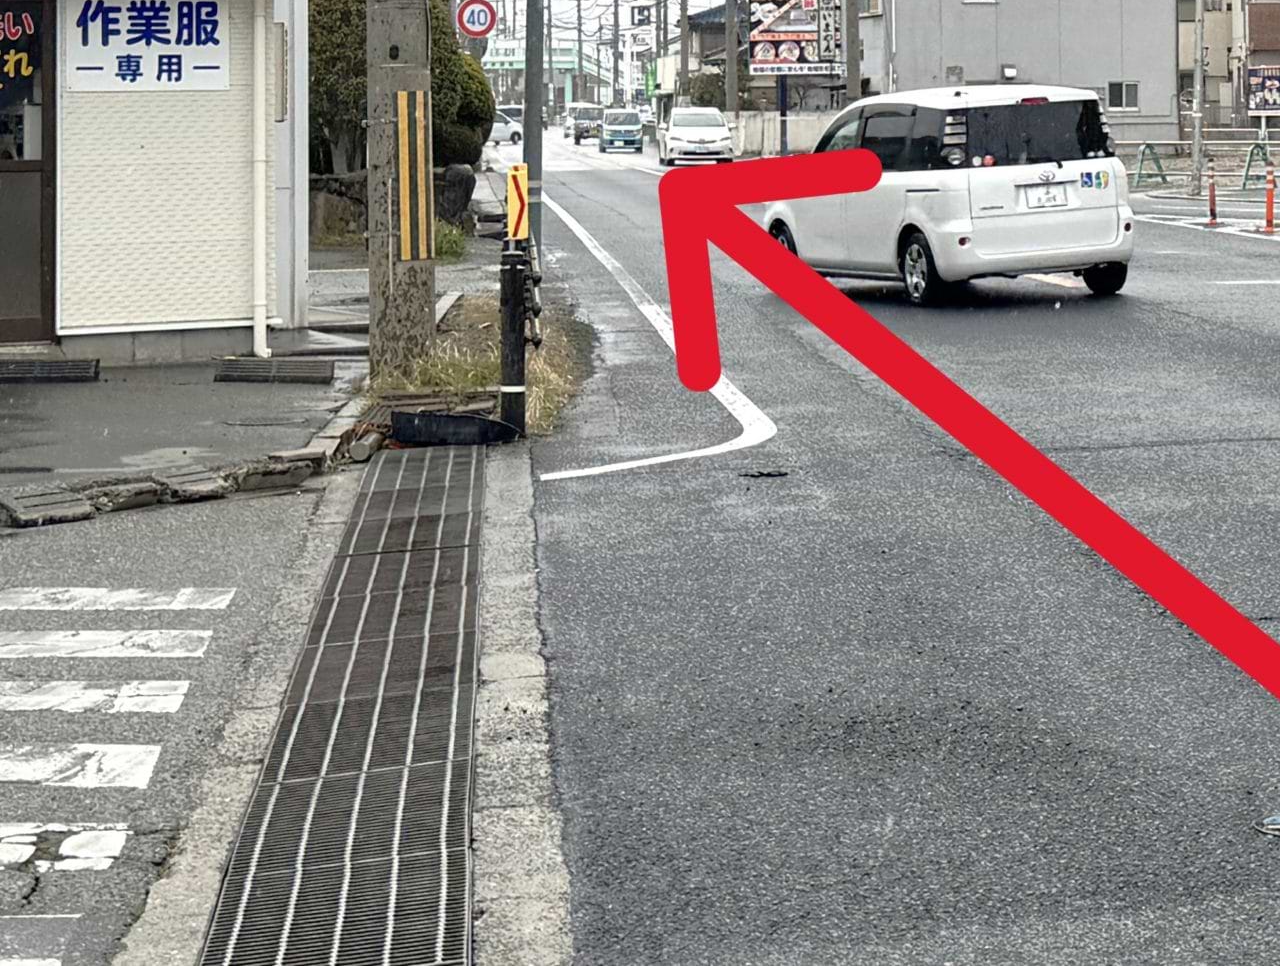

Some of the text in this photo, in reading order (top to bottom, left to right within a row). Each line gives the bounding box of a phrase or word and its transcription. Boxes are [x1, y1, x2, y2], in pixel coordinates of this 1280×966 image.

[76, 0, 220, 47] 作業服
[466, 9, 488, 26] 40
[115, 54, 183, 83] 専用
